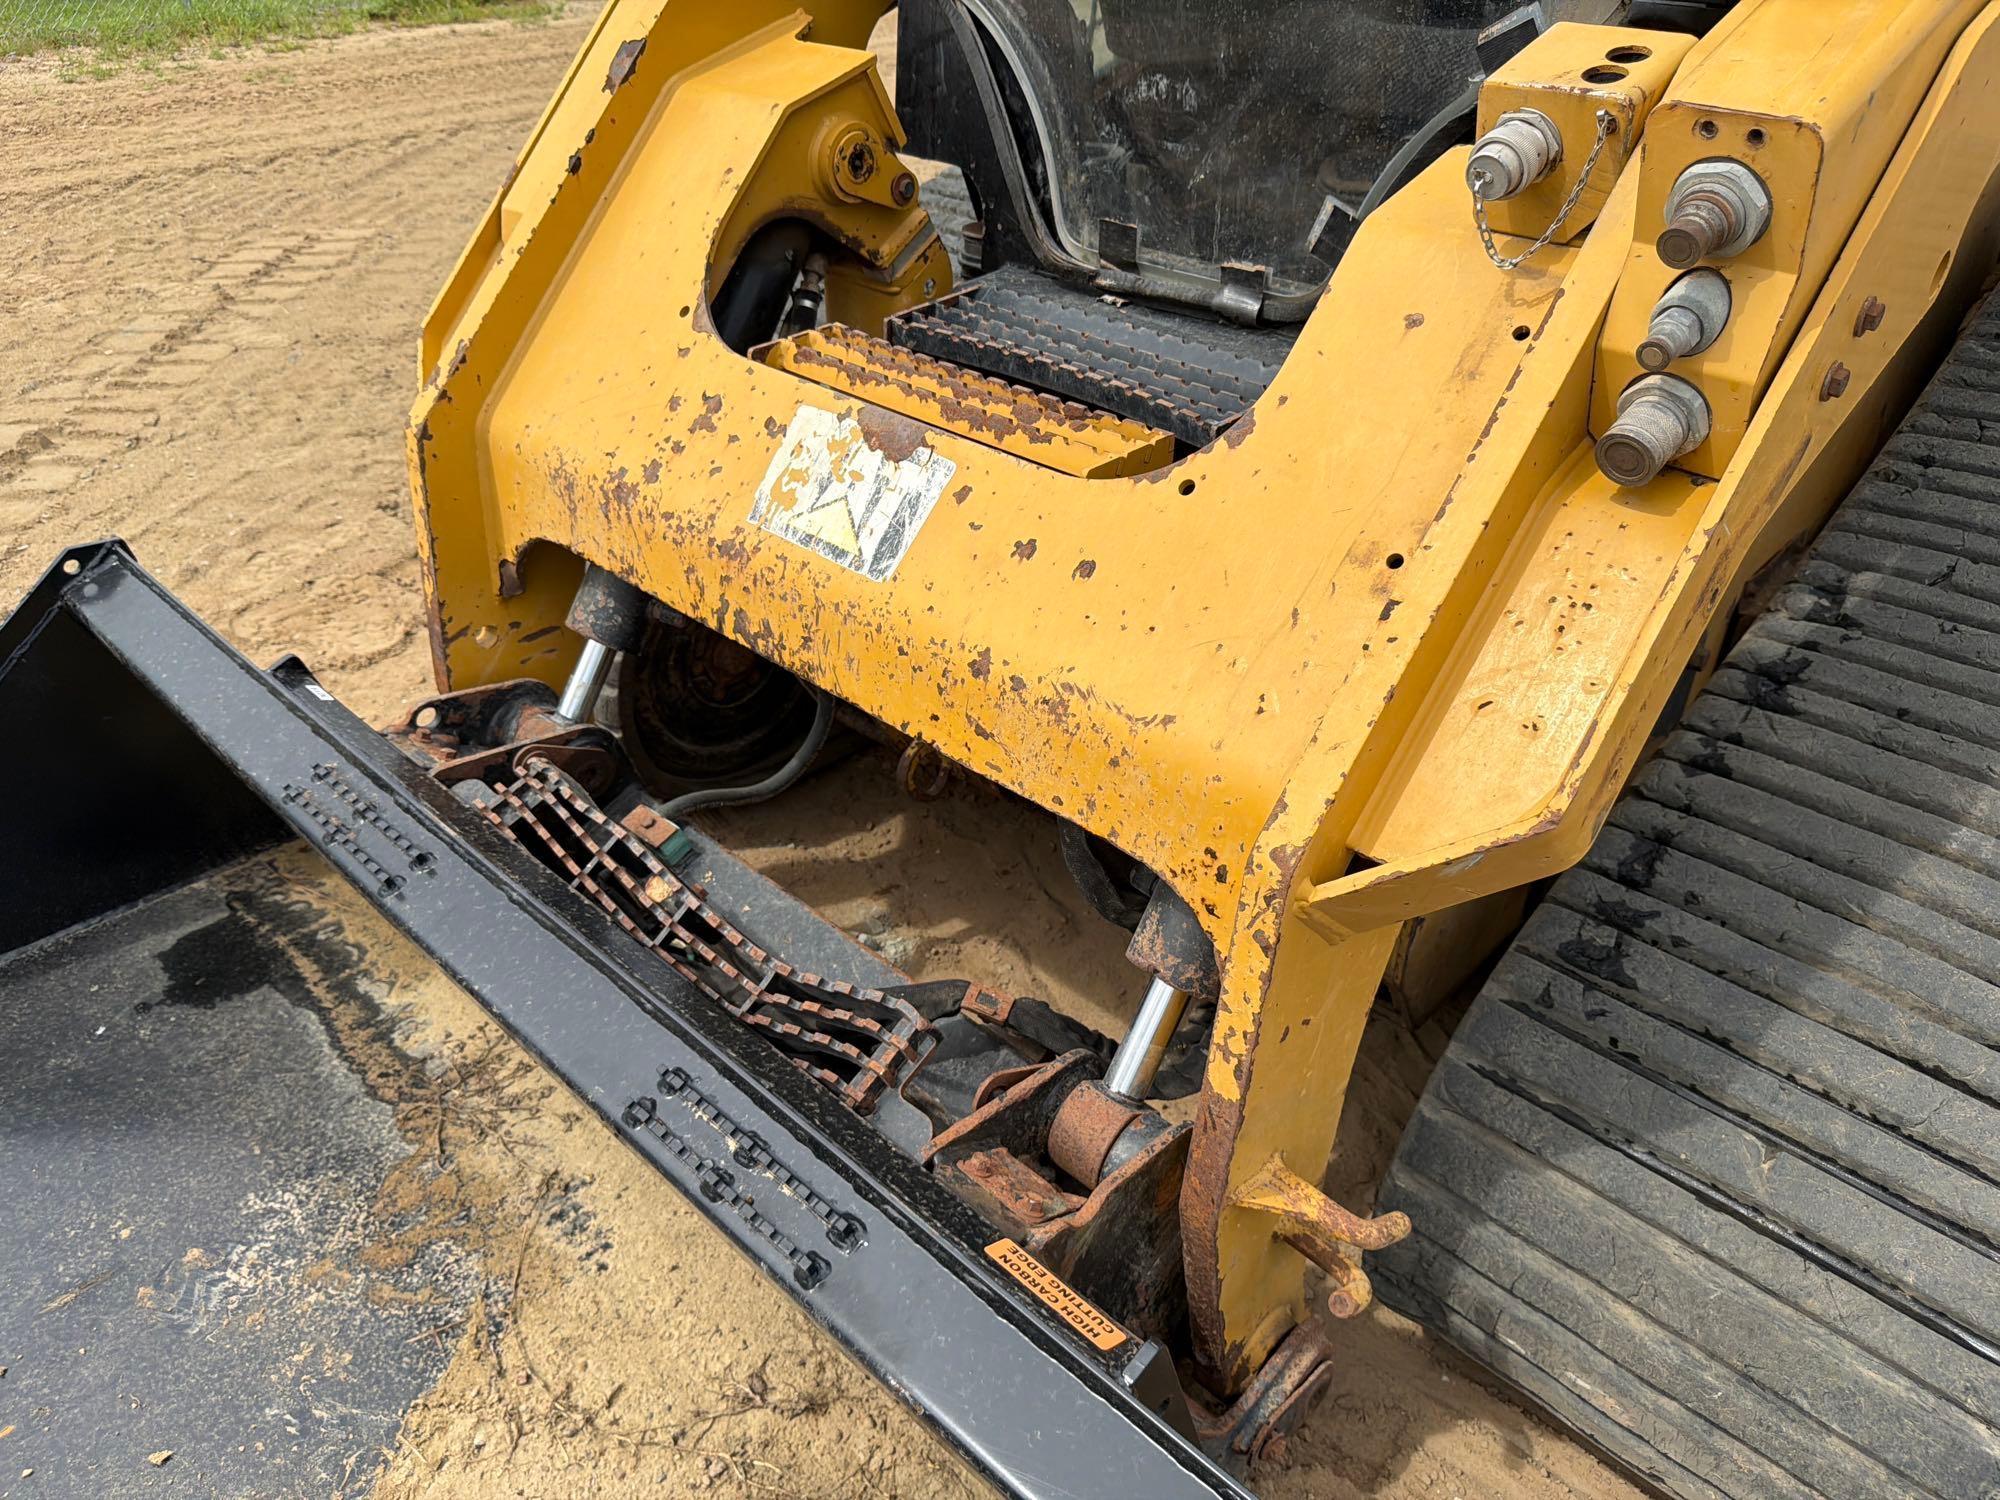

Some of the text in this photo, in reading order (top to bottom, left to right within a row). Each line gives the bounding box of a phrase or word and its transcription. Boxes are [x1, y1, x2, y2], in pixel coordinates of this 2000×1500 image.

[999, 1253, 1101, 1339] HIGH CARBON
[1007, 1245, 1115, 1334] CUTTING EDGE
